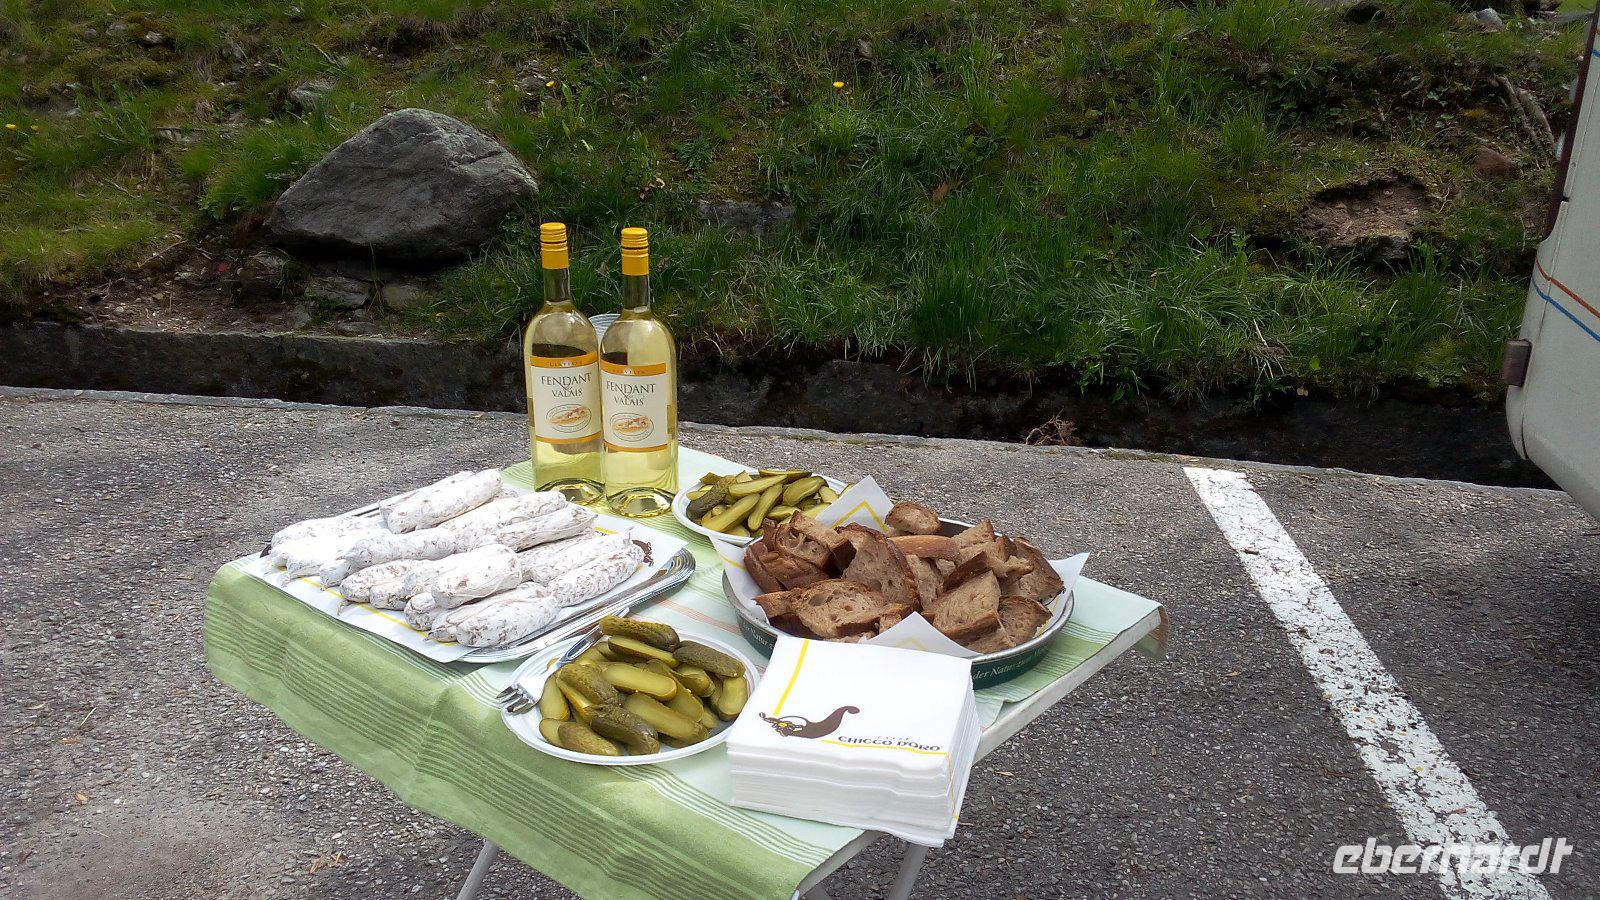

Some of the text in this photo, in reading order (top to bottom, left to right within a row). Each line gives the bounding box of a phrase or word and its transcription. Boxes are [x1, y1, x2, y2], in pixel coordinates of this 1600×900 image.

[541, 372, 592, 391] FENDANT
[551, 388, 583, 398] VALAIS
[606, 380, 656, 400] FENDANT
[613, 396, 644, 406] VALAIS
[838, 735, 892, 746] CHICCO
